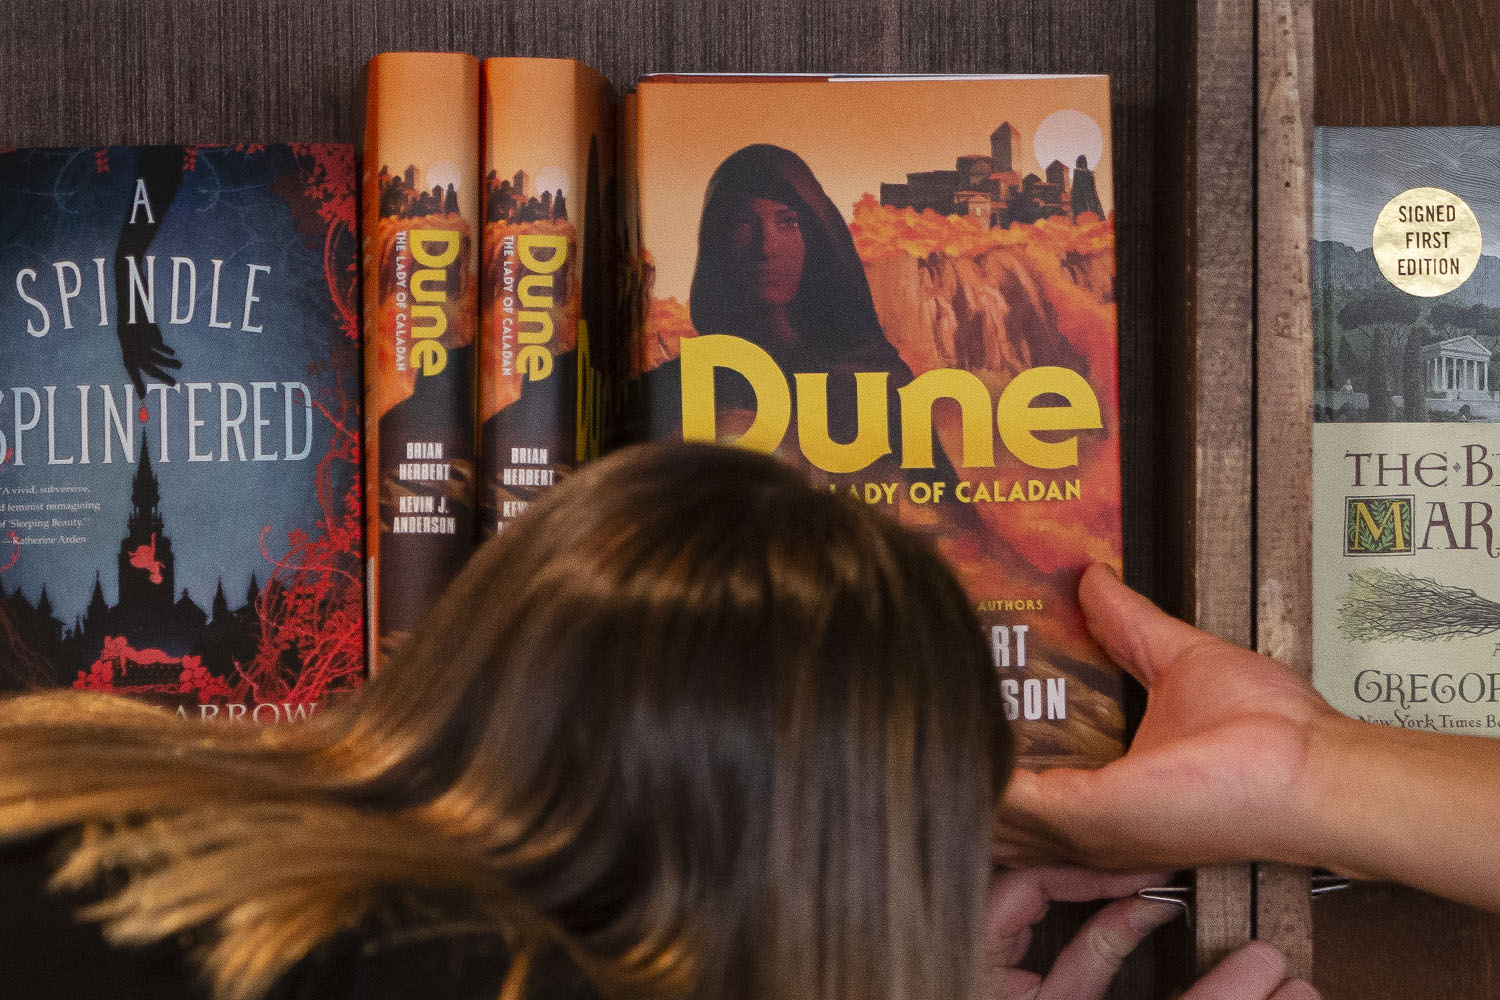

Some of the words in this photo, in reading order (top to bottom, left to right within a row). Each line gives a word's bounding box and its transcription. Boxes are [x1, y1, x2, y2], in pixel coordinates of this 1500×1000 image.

[129, 178, 155, 224] A
[1398, 204, 1457, 224] SIGNED
[396, 231, 407, 251] THE
[503, 235, 514, 254] THE
[1405, 231, 1451, 250] FIRST
[396, 255, 407, 288] LADY
[503, 258, 513, 292] LADY
[1397, 258, 1461, 276] EDITION
[15, 255, 272, 338] SPINDLE
[396, 292, 406, 310] OF
[410, 229, 461, 377] Dune
[502, 296, 512, 313] OF
[515, 234, 568, 381] Dune
[395, 313, 406, 371] CALADAN
[501, 317, 513, 376] CALADAN
[680, 334, 1104, 474] Dune
[0, 381, 314, 466] PLINTERED
[406, 442, 443, 460] BRIAN
[511, 447, 548, 465] BRIAN
[399, 463, 451, 481] HERBERT
[503, 469, 554, 486] HERBERT
[1344, 450, 1449, 489] THE
[909, 482, 946, 504] OF
[955, 479, 1081, 504] CALADAN
[399, 496, 435, 513] KEVIN
[438, 496, 450, 513] J.
[393, 516, 456, 534] ANDERSON
[977, 599, 1044, 612] AUTHORS
[1393, 709, 1440, 732] York
[1438, 714, 1482, 729] Times
